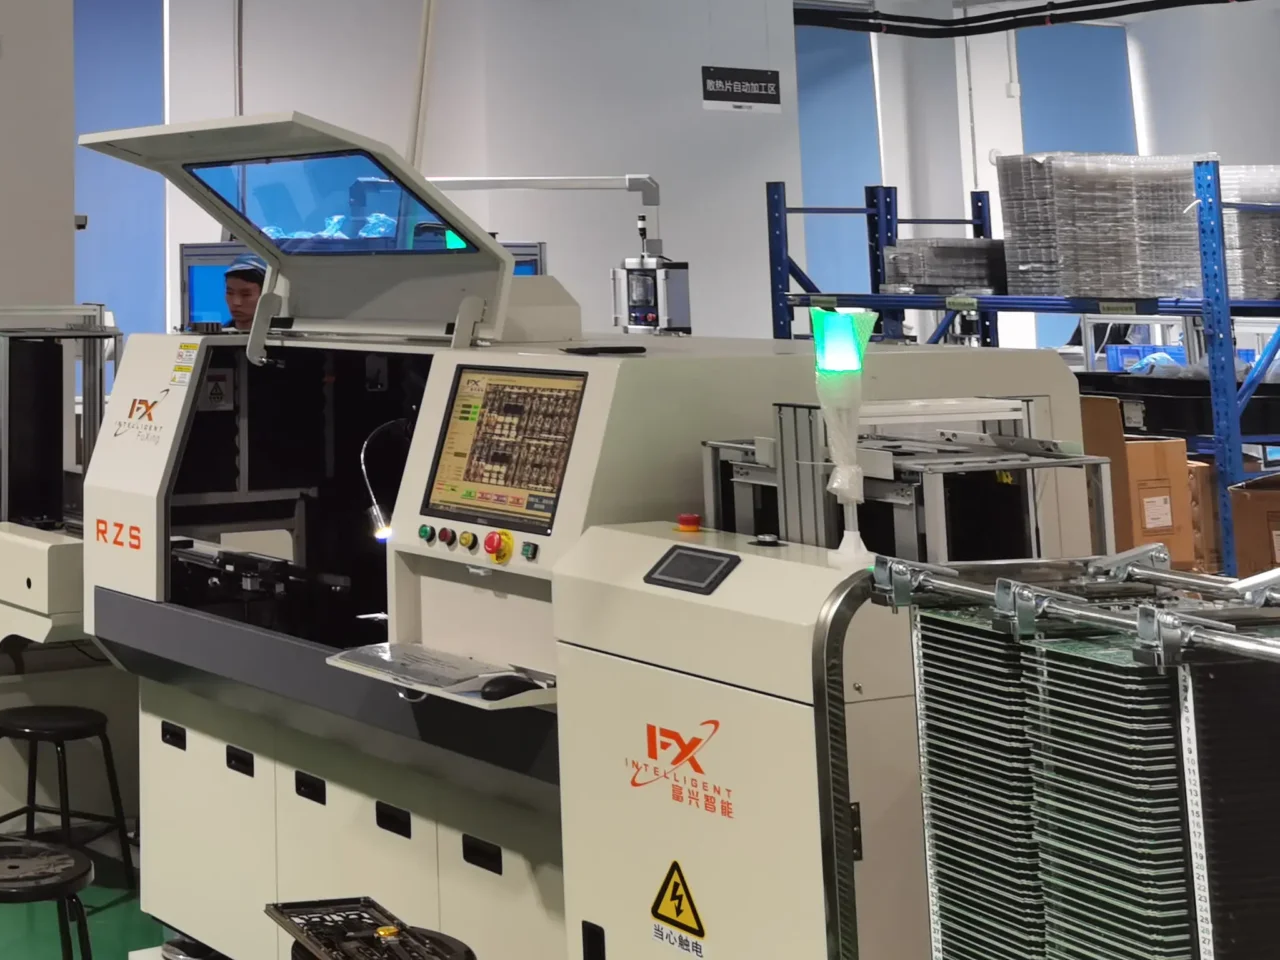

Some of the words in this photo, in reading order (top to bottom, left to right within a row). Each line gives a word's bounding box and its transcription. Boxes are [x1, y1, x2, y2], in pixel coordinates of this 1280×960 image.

[96, 518, 142, 551] RZS
[646, 723, 705, 775] FX
[624, 757, 733, 798] INTELLIGENT
[671, 783, 734, 819] 富兴智能
[652, 923, 705, 958] 当心触电
